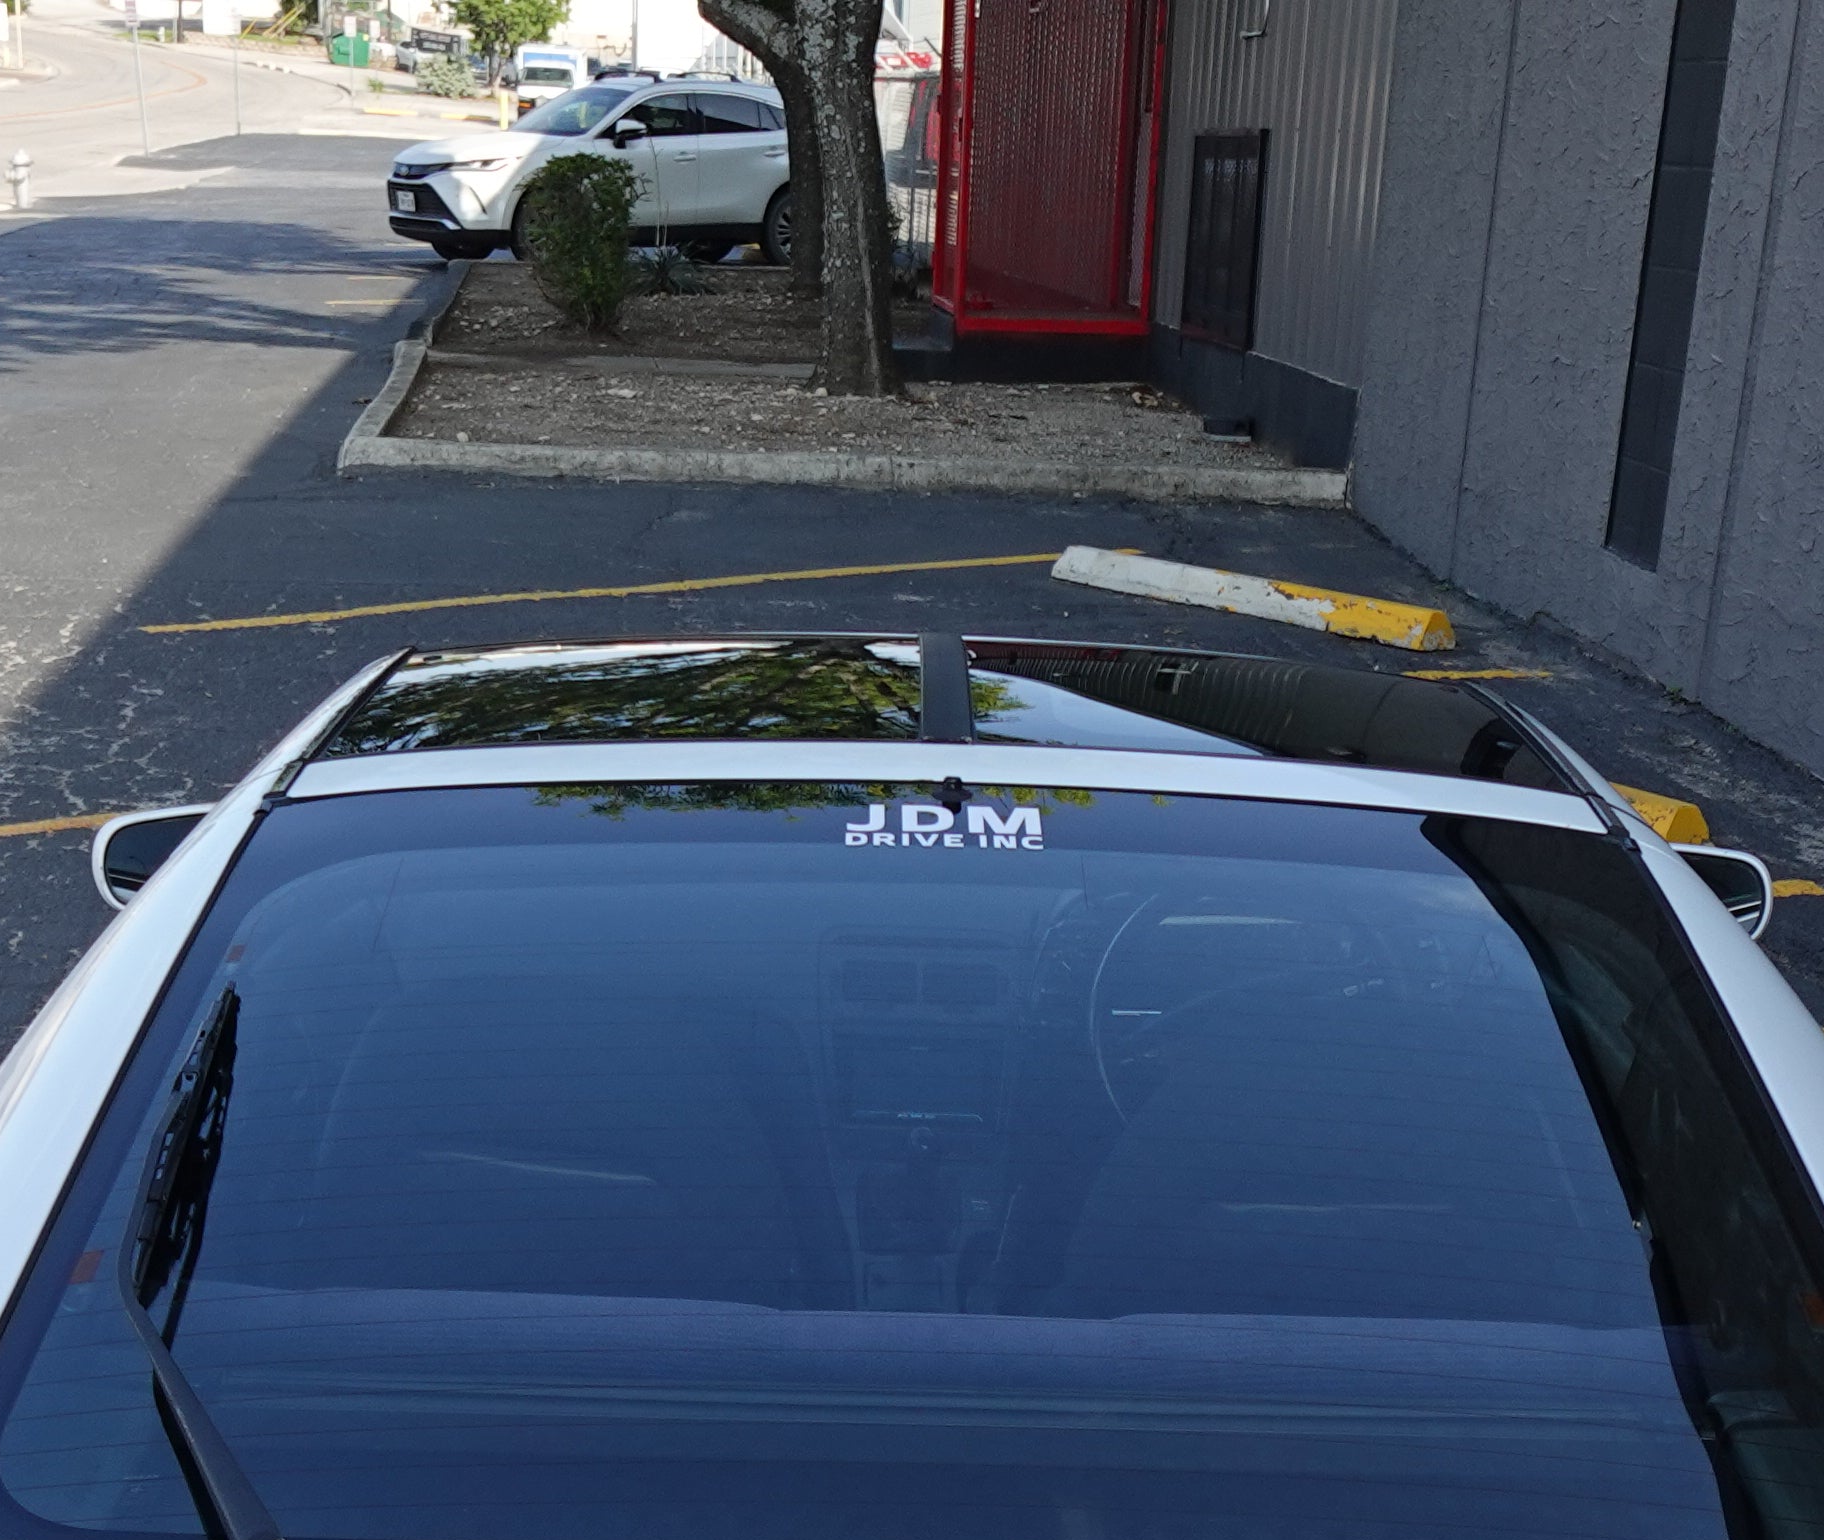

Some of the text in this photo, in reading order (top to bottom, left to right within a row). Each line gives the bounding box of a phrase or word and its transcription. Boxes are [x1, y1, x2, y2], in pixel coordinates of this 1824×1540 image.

[845, 803, 1043, 834] JDM
[844, 832, 1045, 850] DRIVE INC
